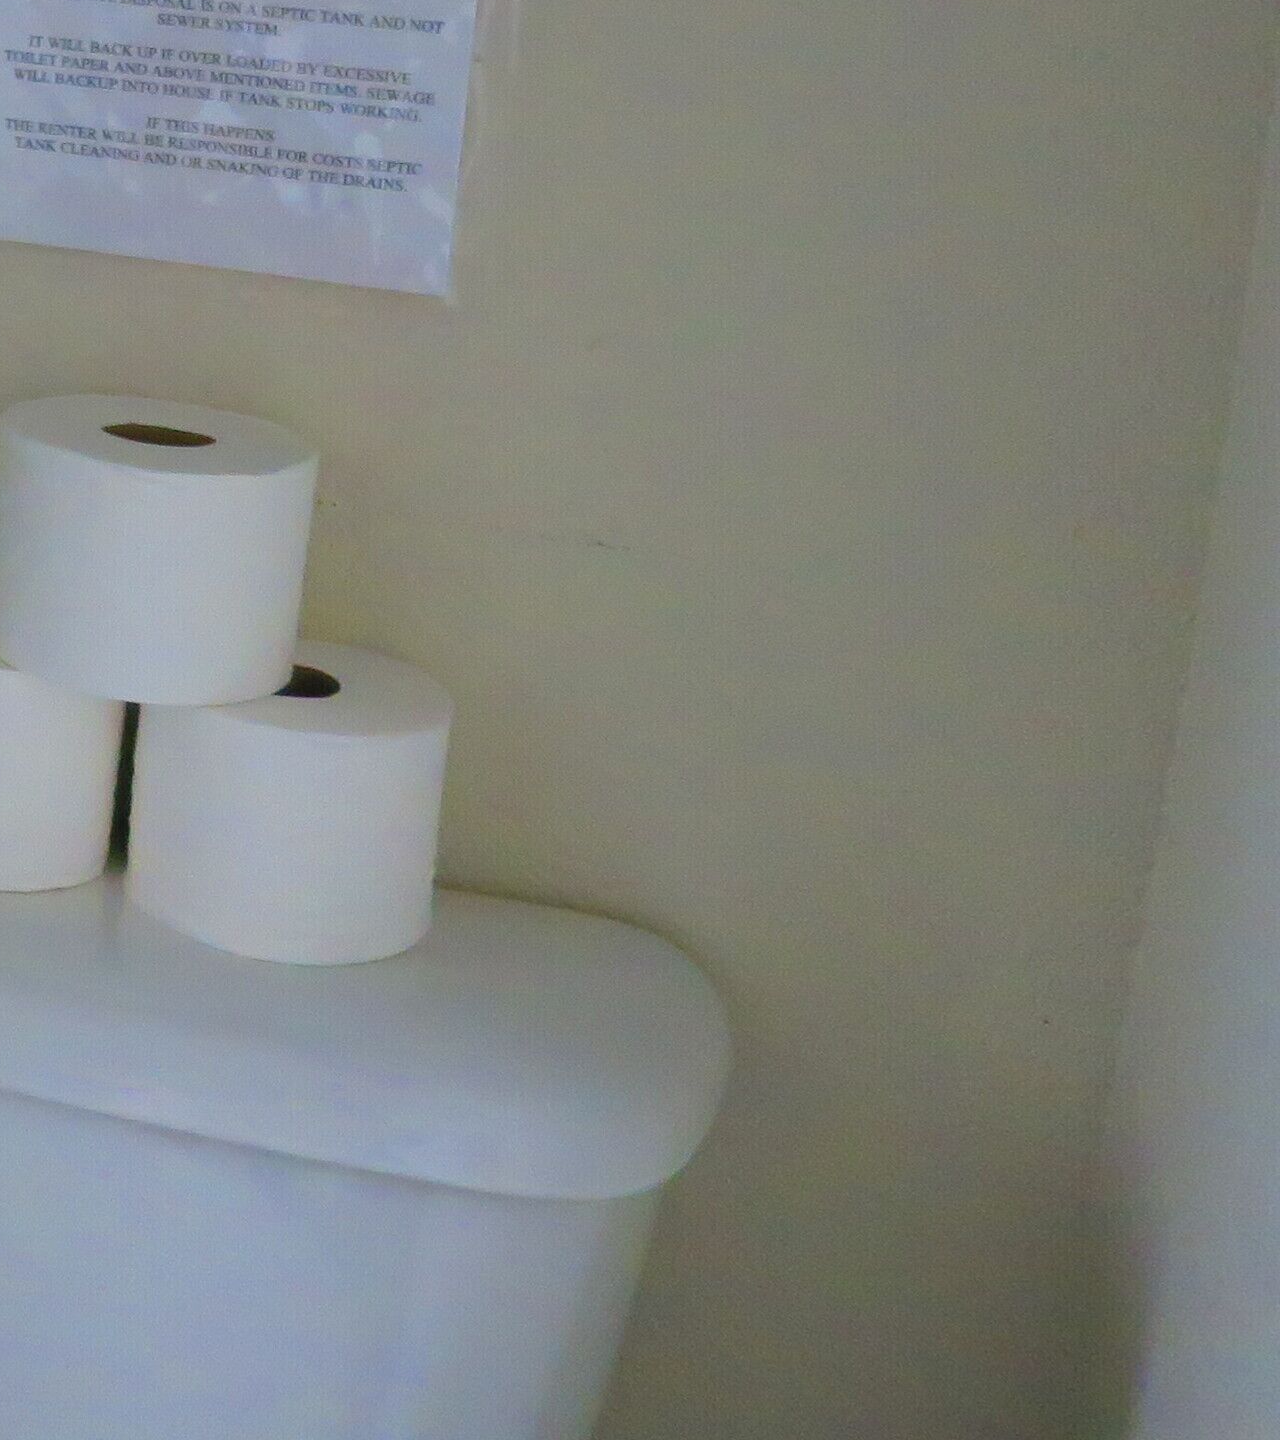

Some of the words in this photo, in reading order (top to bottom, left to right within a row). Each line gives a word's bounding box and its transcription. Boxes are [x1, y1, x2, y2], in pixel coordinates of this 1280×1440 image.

[158, 13, 210, 29] SEWER
[200, 0, 214, 12] IS
[219, 1, 241, 15] ON
[262, 5, 318, 22] SEPTIC
[320, 11, 366, 27] TANK
[370, 16, 406, 31] AND
[410, 19, 446, 35] NOT
[4, 50, 56, 66] TOILET
[62, 56, 109, 72] PAPER
[114, 61, 148, 76] AND
[153, 65, 203, 81] ABOVE
[210, 71, 305, 92] MENTIONED
[366, 87, 436, 105] SEWAGE
[30, 35, 44, 47] IT
[47, 37, 85, 51] WILL
[90, 41, 135, 56] BACK
[137, 46, 157, 59] UP
[161, 48, 174, 60] IF
[178, 50, 223, 65] OVER
[226, 55, 293, 73] LOADED
[297, 62, 321, 75] BY
[323, 65, 412, 85] EXCESSIVE
[14, 68, 50, 83] WILL
[55, 73, 118, 90] BACKUP
[121, 79, 160, 94] INTO
[163, 84, 214, 100] HOUSE
[219, 90, 232, 102] IF
[240, 92, 281, 107] TANK
[286, 97, 335, 113] STOPS
[341, 102, 423, 122] WORKING.
[6, 119, 33, 133] THE
[39, 123, 98, 140] RENTER
[102, 130, 137, 144] WILL
[144, 134, 164, 147] BE
[168, 137, 272, 159] RESPONSIBLE
[277, 149, 308, 163] FOR
[312, 153, 363, 169] COSTS
[367, 159, 423, 176] SEPTIC
[147, 117, 160, 129] IF
[167, 119, 200, 133] THIS
[204, 123, 275, 142] HAPPENS
[15, 137, 57, 152] TANK
[61, 142, 139, 162] CLEANING
[144, 151, 177, 166] AND
[182, 155, 202, 169] OR
[206, 158, 279, 178] SNAKING
[282, 167, 304, 180] OF
[308, 170, 336, 184] THE
[342, 173, 409, 192] DRAINS.
